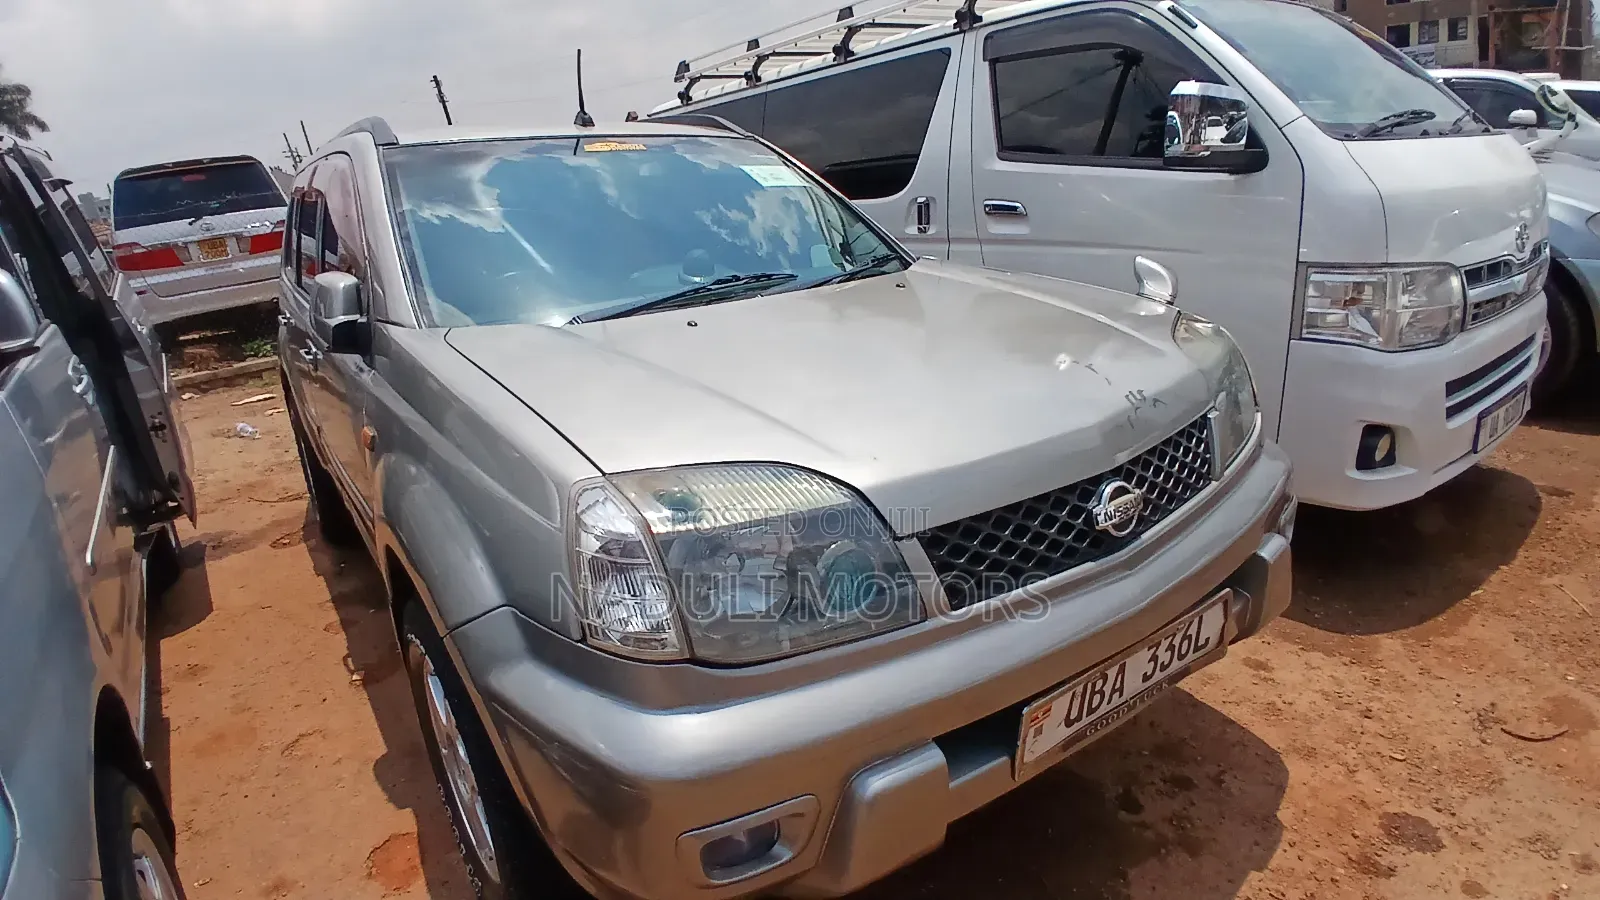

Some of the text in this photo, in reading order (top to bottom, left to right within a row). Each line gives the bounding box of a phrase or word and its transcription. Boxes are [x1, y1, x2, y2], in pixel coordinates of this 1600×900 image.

[1063, 615, 1210, 729] UBA 336L
[1085, 681, 1170, 737] GOOD LUCK
